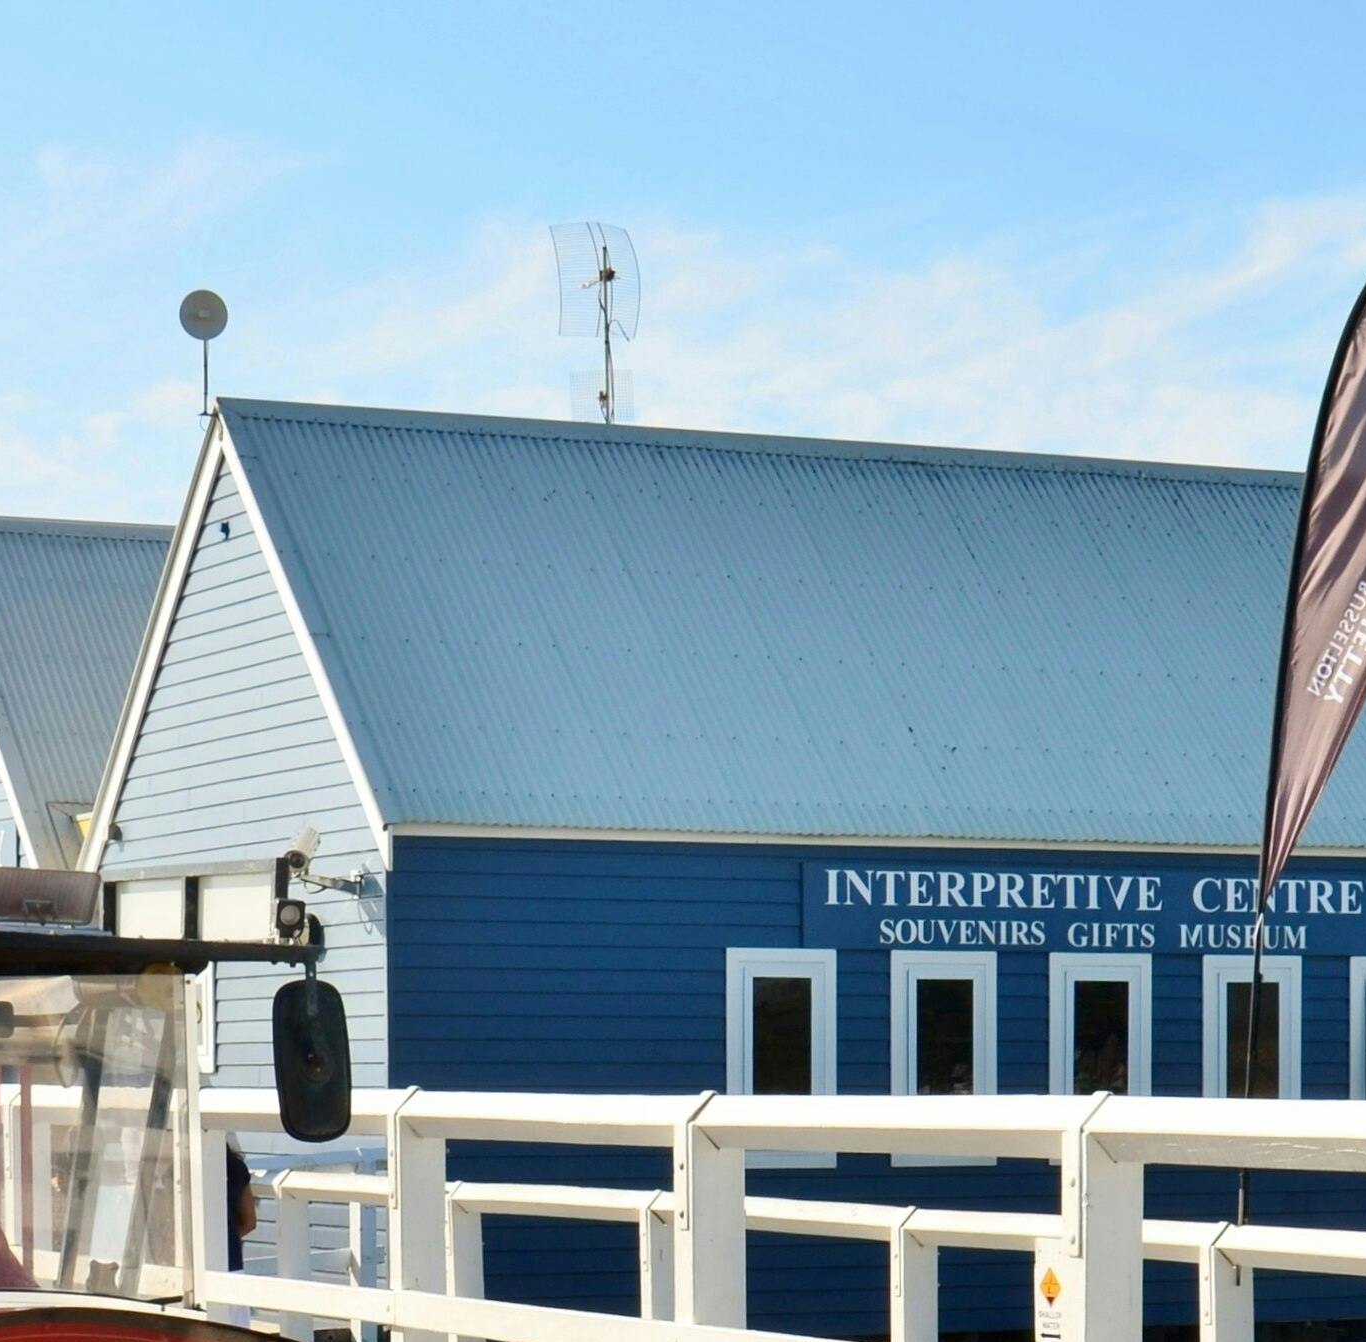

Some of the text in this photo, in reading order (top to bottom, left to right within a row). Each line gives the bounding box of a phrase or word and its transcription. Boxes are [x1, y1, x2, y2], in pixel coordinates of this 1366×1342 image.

[824, 868, 1163, 914] INTERPRETIVE
[879, 918, 1046, 947] SOUVENIRS
[1067, 922, 1156, 949] GIFTS
